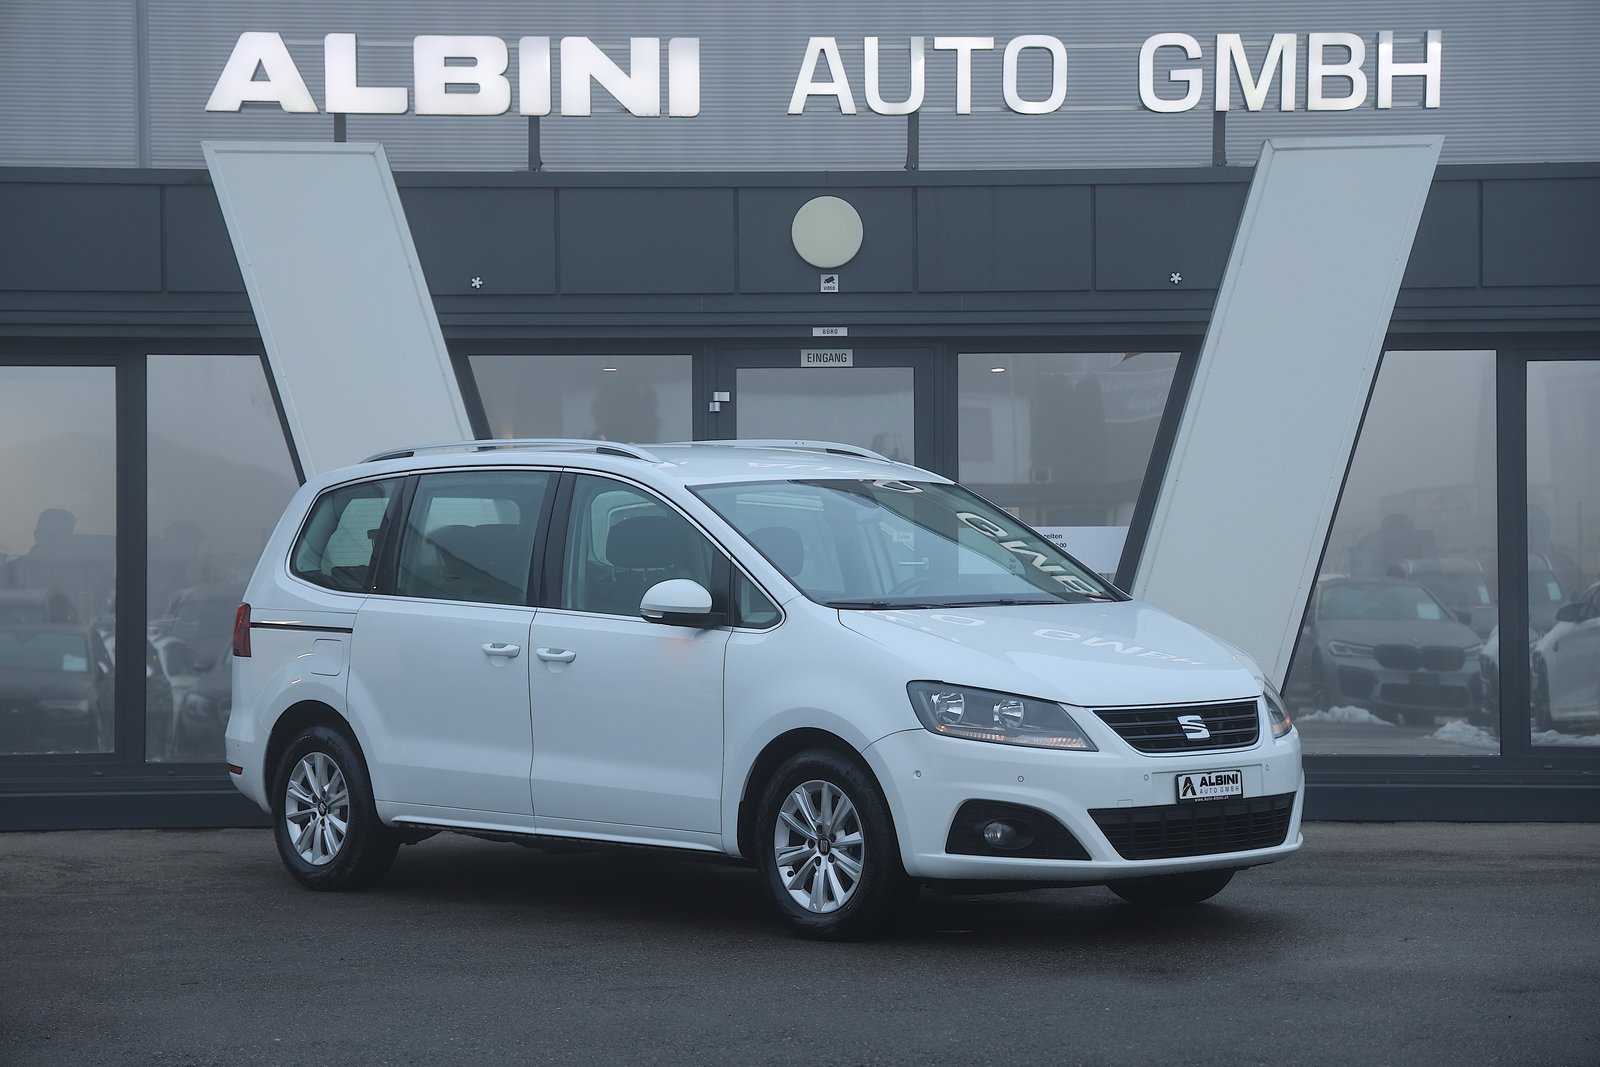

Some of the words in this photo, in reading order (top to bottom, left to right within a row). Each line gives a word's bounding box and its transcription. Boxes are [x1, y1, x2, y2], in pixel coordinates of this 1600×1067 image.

[204, 31, 700, 118] ALBINI
[787, 34, 1068, 116] AUTO
[1138, 30, 1442, 114] GMBH
[807, 353, 847, 363] EINGANG
[1200, 774, 1239, 787] ALBINI
[1200, 787, 1218, 795] AUTO
